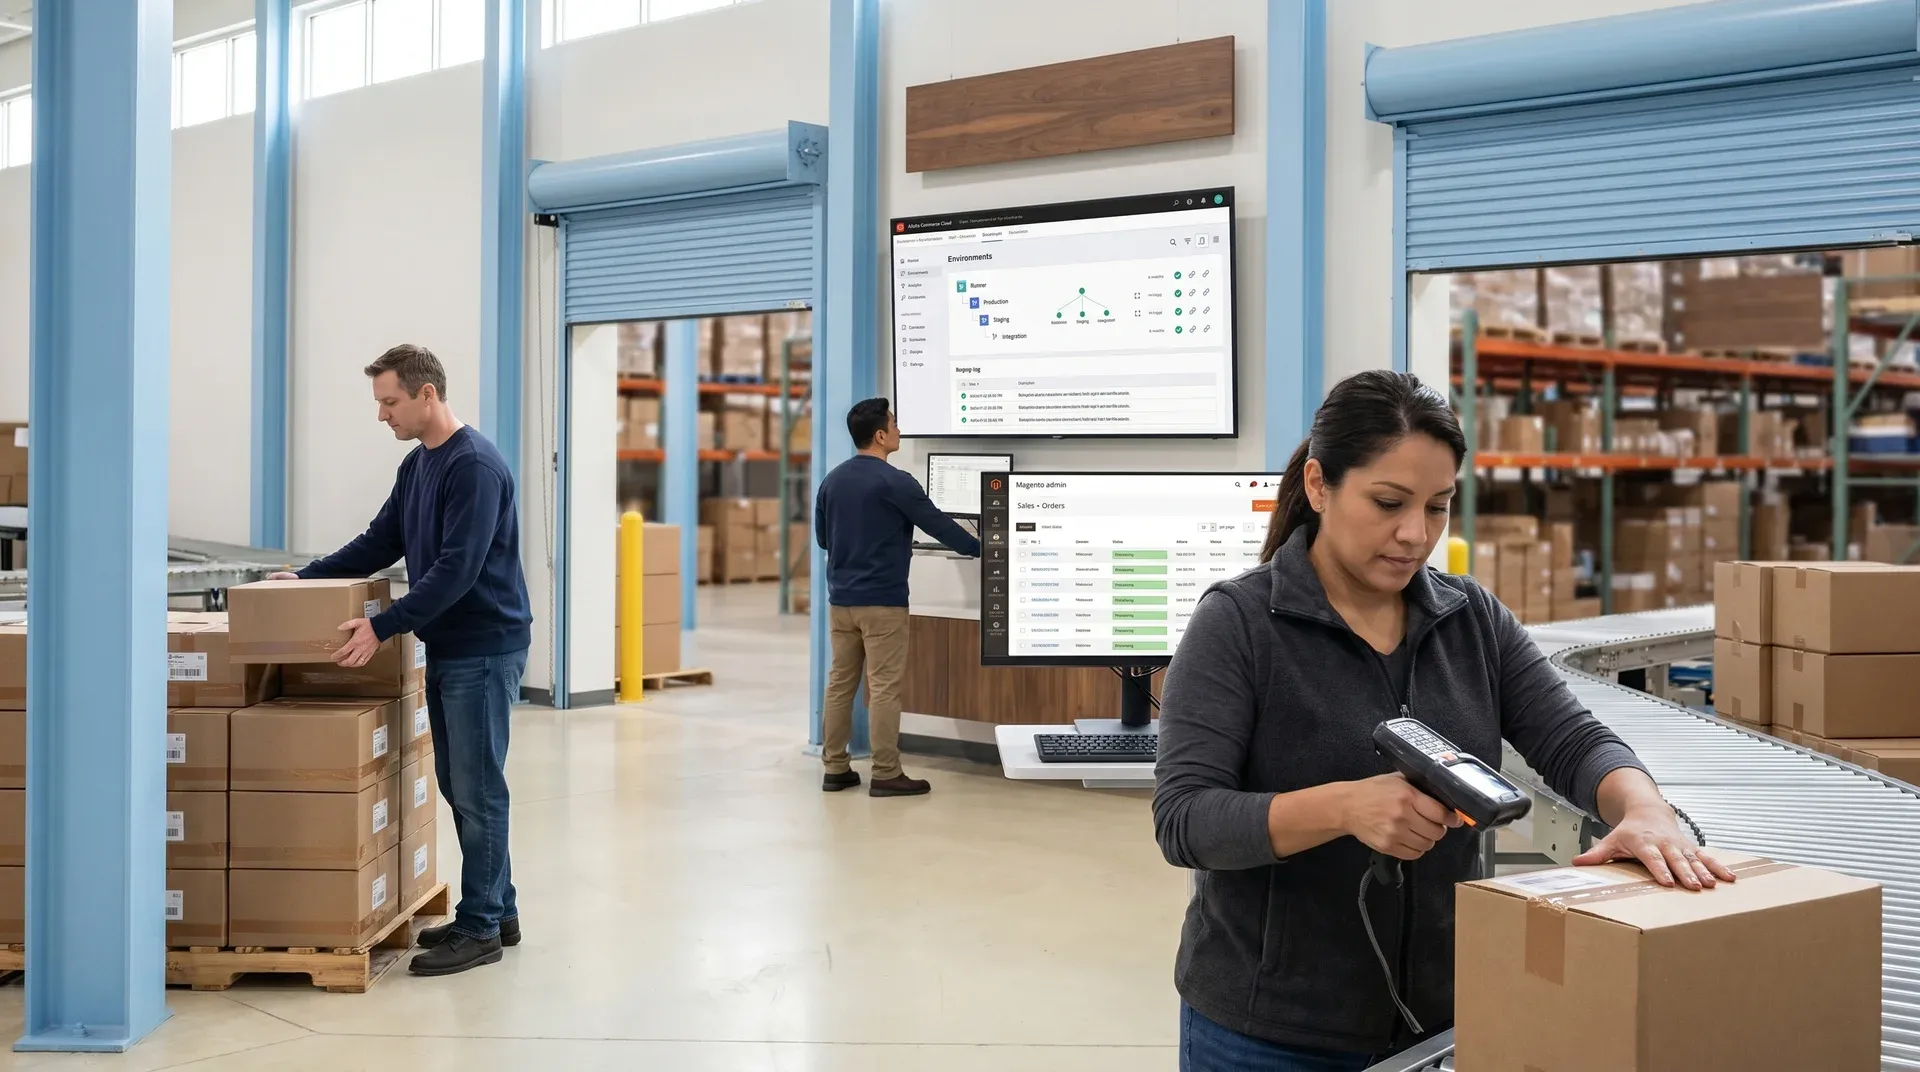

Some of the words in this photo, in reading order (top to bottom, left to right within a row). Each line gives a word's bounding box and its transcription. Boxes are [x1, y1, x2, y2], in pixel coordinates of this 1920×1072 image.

[947, 253, 993, 263] Environments
[993, 316, 1010, 324] Staging
[1002, 333, 1028, 341] Integration
[1015, 481, 1045, 490] Magento
[1017, 502, 1035, 510] Sales
[1041, 502, 1066, 510] Orders
